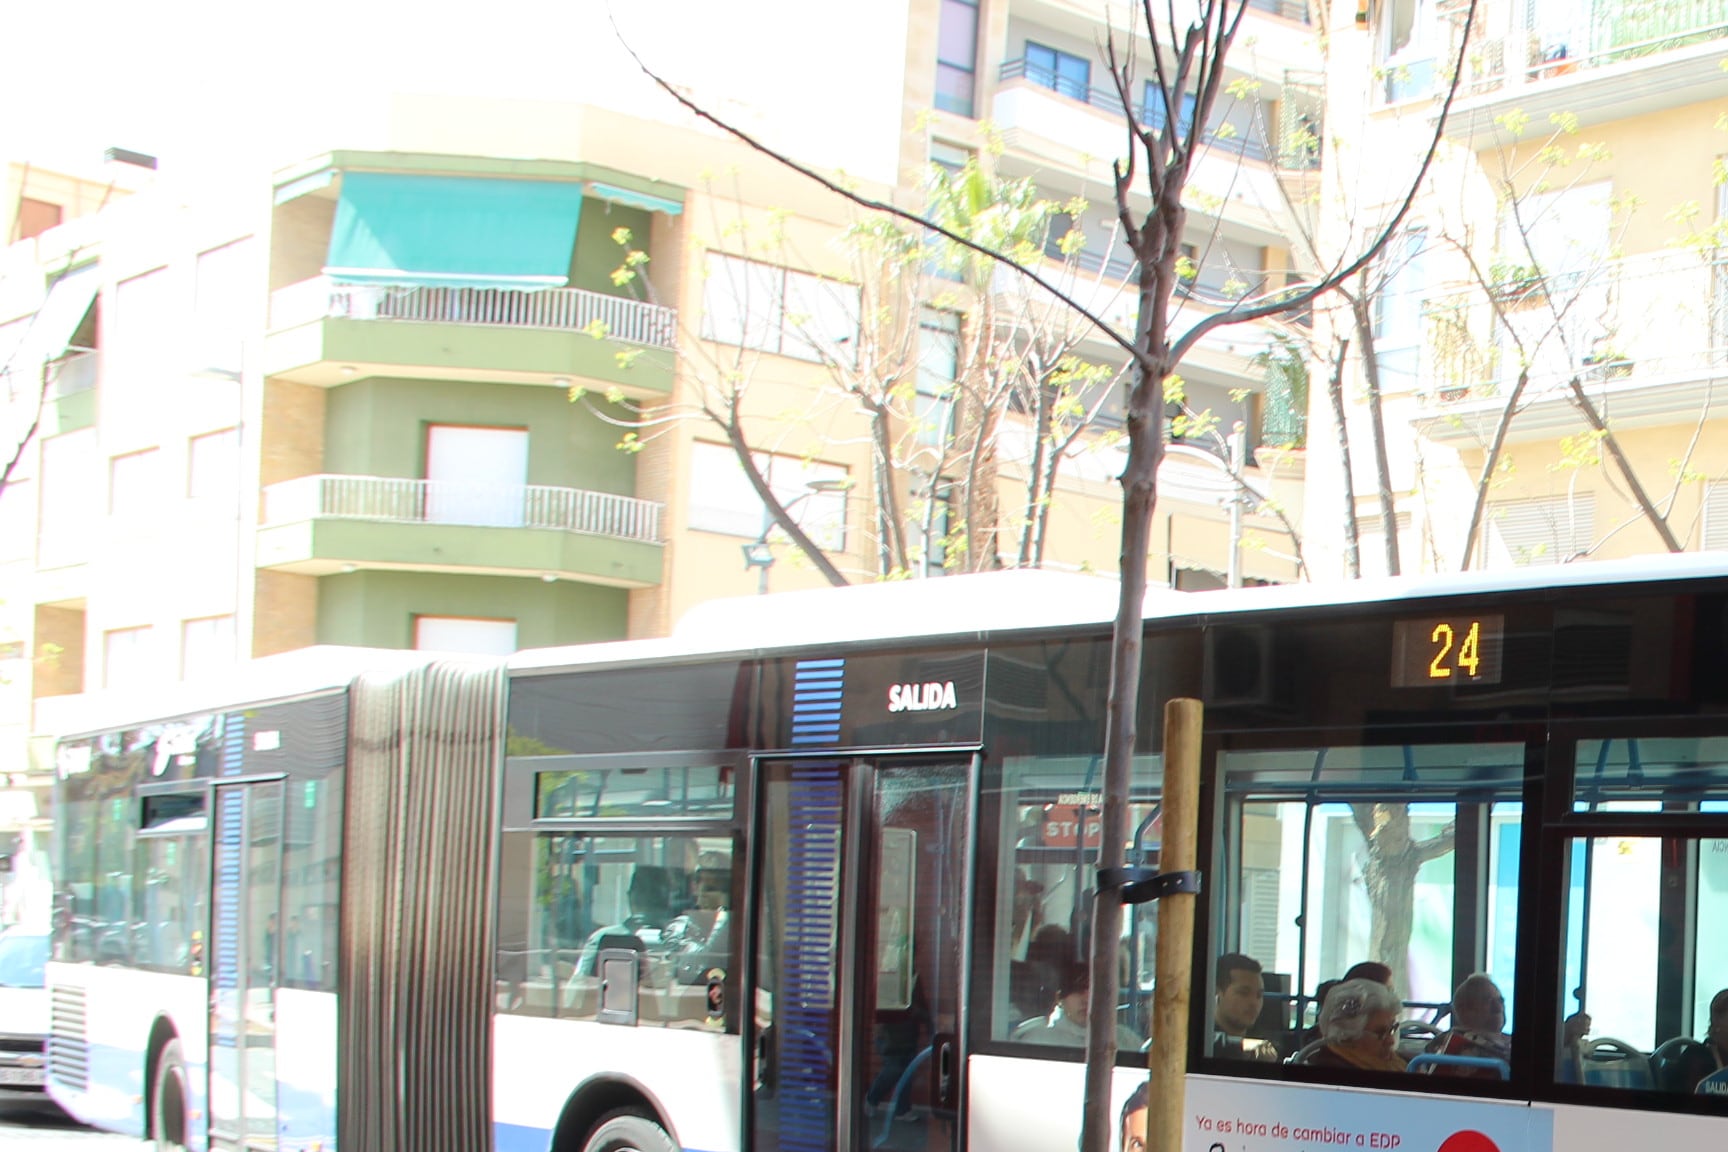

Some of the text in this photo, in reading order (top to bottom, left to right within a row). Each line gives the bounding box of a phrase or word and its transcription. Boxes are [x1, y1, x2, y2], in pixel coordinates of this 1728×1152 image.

[1430, 622, 1480, 678] 24
[888, 681, 957, 712] SALIDA
[1196, 1115, 1401, 1149] Ya es hora de cambiar a EDP
